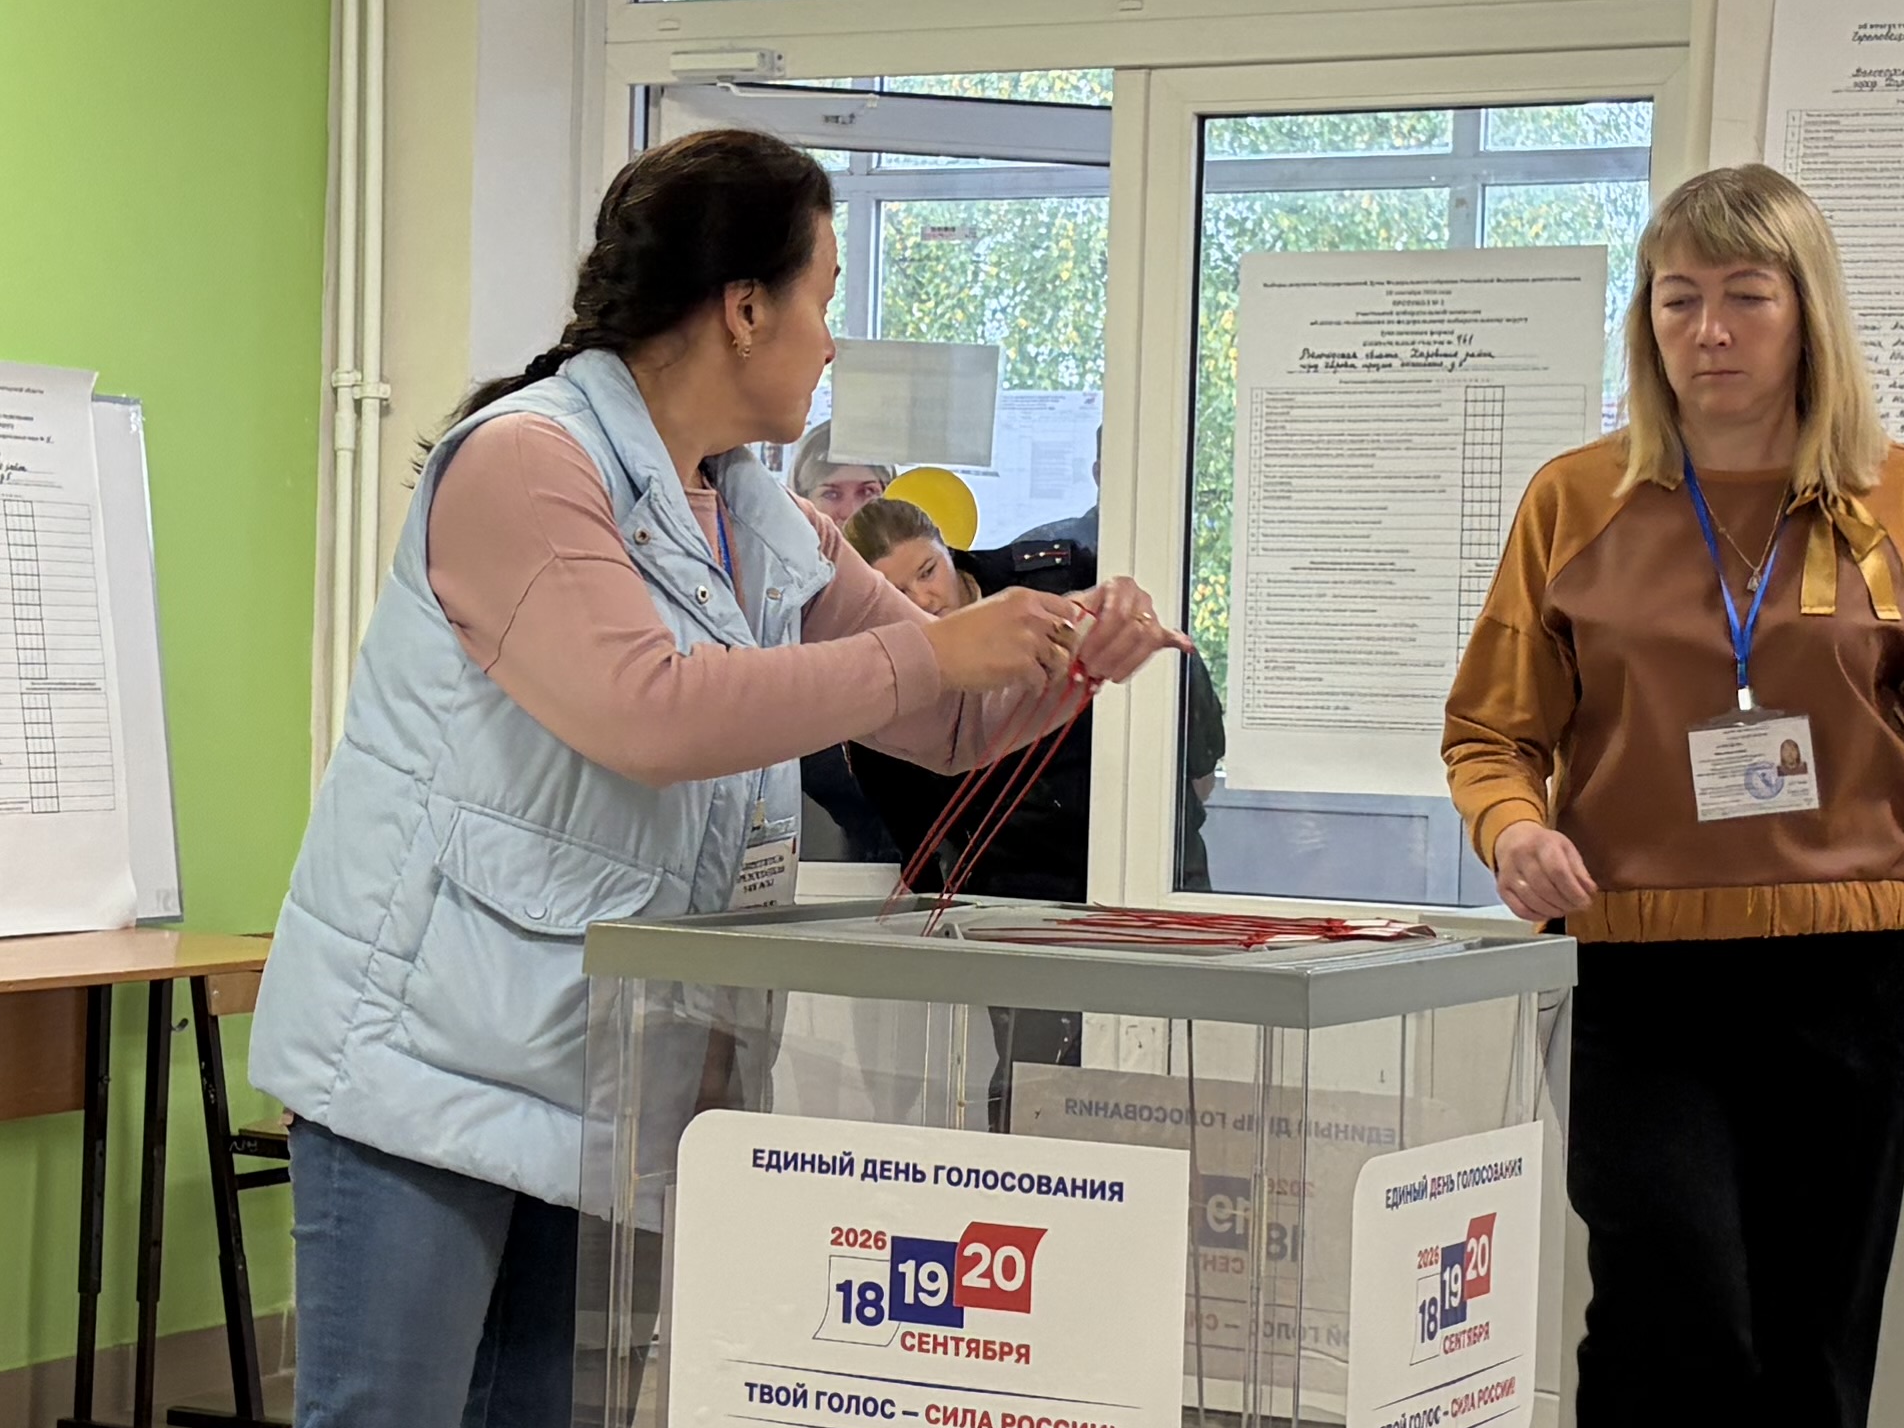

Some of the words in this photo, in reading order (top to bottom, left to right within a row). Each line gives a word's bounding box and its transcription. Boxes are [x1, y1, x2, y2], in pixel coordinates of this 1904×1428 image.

[752, 1147, 855, 1178] ЕДИНЫЙ
[860, 1158, 927, 1186] ДЕНЬ
[933, 1163, 1125, 1203] ГОЛОСОВАНИЯ
[1385, 1174, 1428, 1211] ЕДИНЫЙ
[1429, 1173, 1456, 1201] ДЕНЬ
[1456, 1156, 1523, 1191] ГОЛОСОВАНИЯ
[829, 1225, 888, 1251] 2026
[836, 1279, 886, 1327] 18
[897, 1259, 949, 1307] 19
[961, 1242, 1027, 1292] 20
[1418, 1295, 1438, 1345] 18
[1442, 1263, 1463, 1312] 19
[1465, 1233, 1490, 1281] 20
[899, 1330, 1032, 1366] СЕНТЯБРЯ
[1442, 1320, 1491, 1356] СЕНТЯБРЯ
[744, 1380, 809, 1410] ТВОЙ
[814, 1390, 896, 1421] ГОЛОС
[1450, 1391, 1477, 1419] СИЛА
